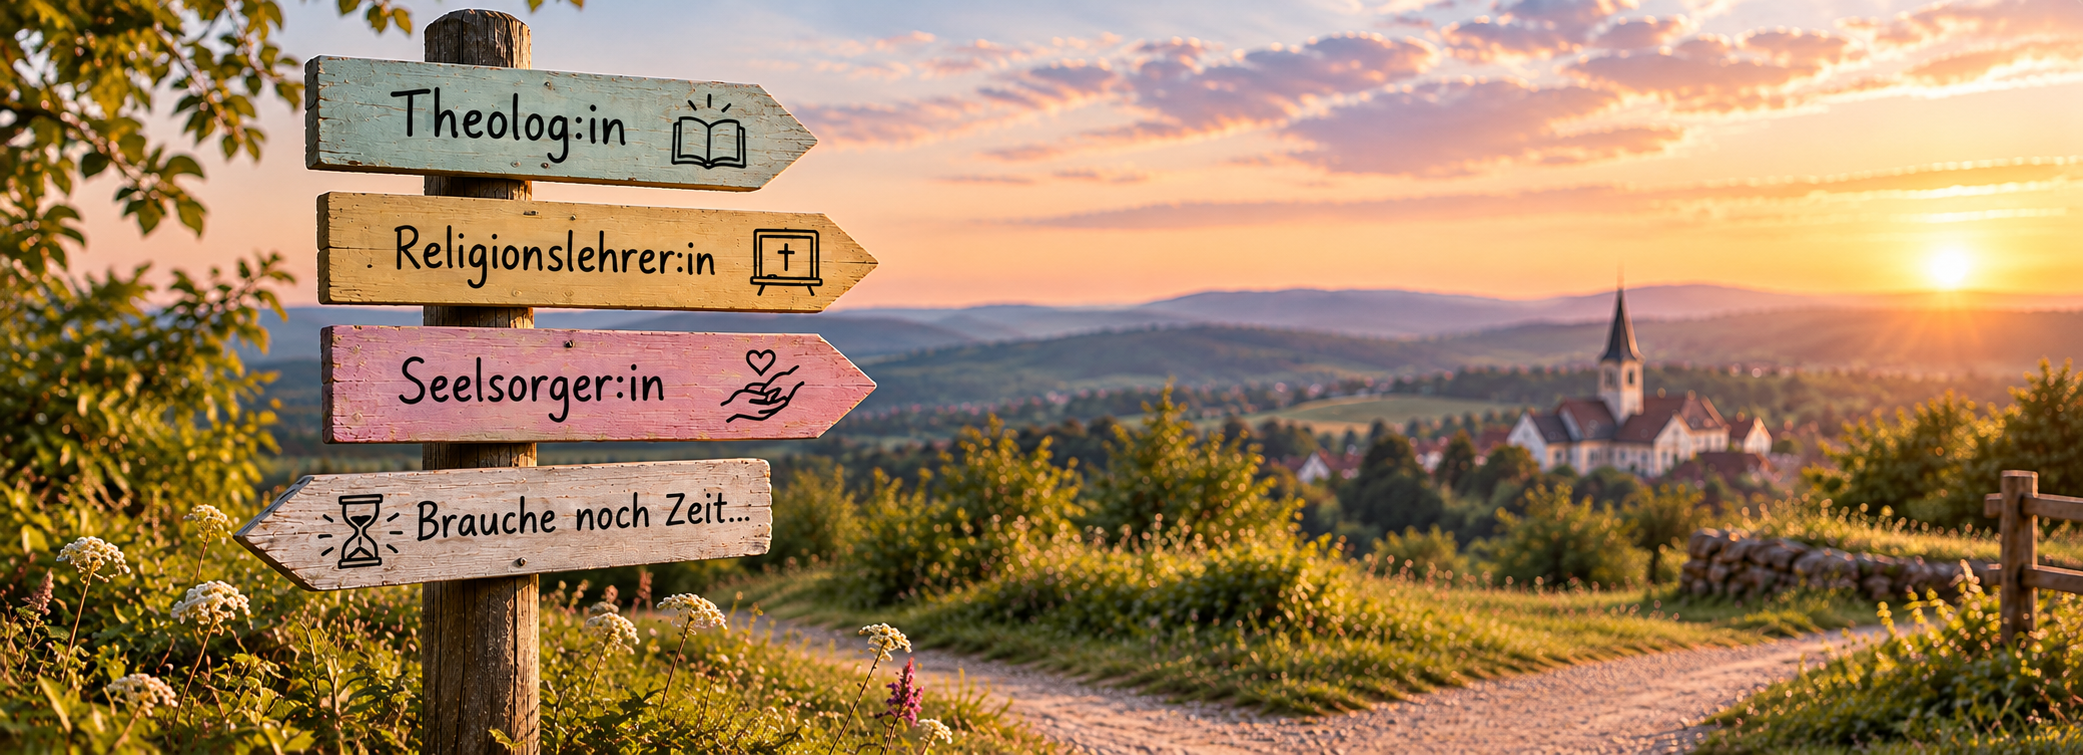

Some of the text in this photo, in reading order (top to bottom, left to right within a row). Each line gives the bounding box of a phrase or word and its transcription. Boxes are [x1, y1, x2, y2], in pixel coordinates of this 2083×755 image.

[390, 86, 626, 164] Theolog:in
[394, 224, 715, 289] Religionslehrer:in
[398, 356, 664, 423] Seelsorger:in
[416, 491, 750, 542] Brauche noch Zeit...
